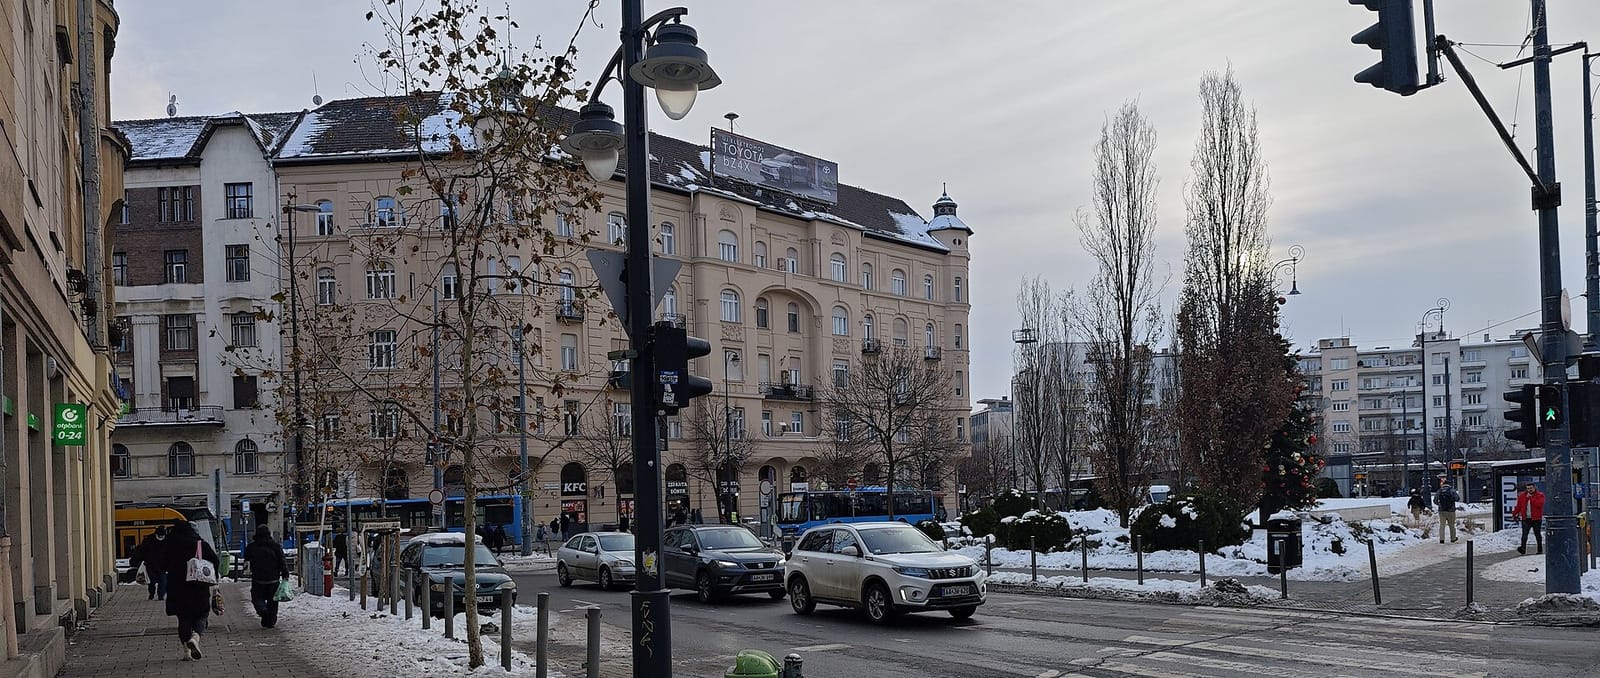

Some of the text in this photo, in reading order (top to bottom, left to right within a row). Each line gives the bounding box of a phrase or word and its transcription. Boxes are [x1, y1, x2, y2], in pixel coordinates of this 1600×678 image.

[722, 142, 763, 163] TOYOTA
[723, 155, 751, 173] bZ4X
[58, 431, 82, 440] 0-24
[563, 482, 587, 492] KFC
